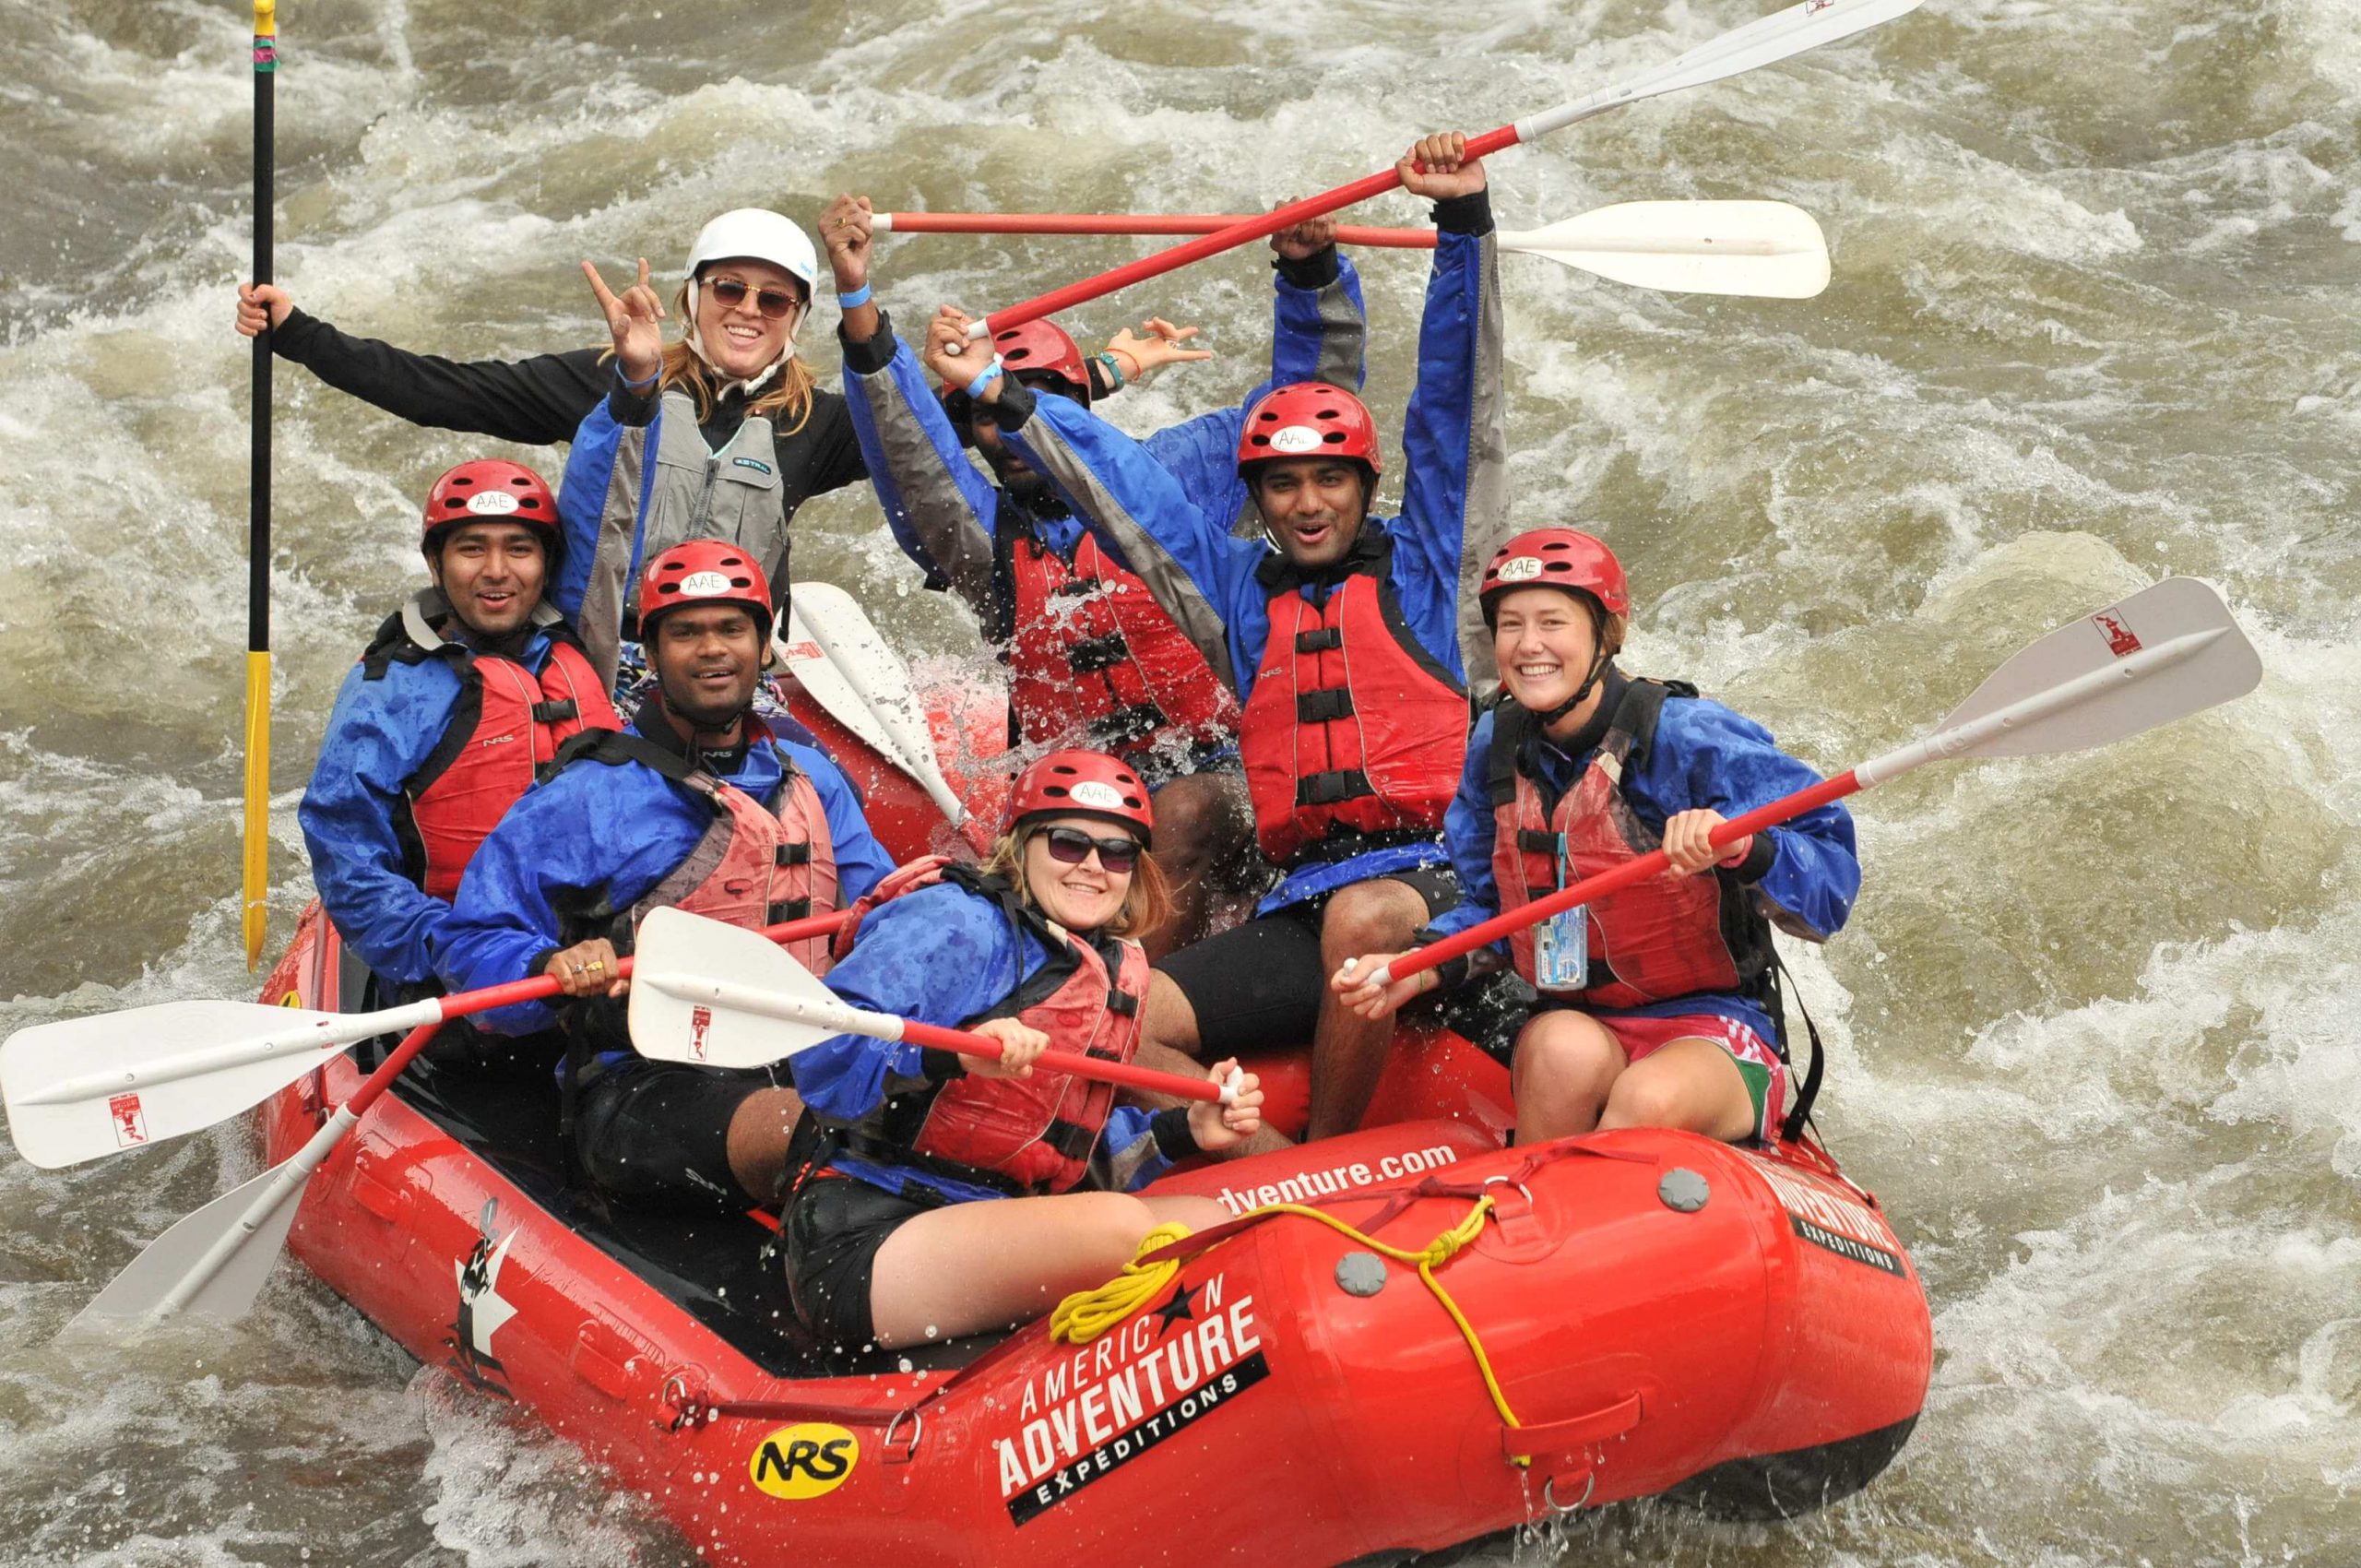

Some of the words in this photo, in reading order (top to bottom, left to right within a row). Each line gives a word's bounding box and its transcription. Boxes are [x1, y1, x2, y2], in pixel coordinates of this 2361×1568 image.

[475, 494, 509, 508] AAE
[1503, 559, 1536, 576] AAE
[687, 575, 723, 590] AAE
[482, 734, 515, 748] NRS
[702, 750, 733, 758] NRS
[1079, 784, 1113, 802] AAE
[1801, 1220, 1894, 1271] EXPEDITIONS
[999, 1295, 1262, 1498] ADVENTURE
[1037, 1373, 1238, 1504] EXPEDITIONS
[756, 1439, 852, 1483] NRS
